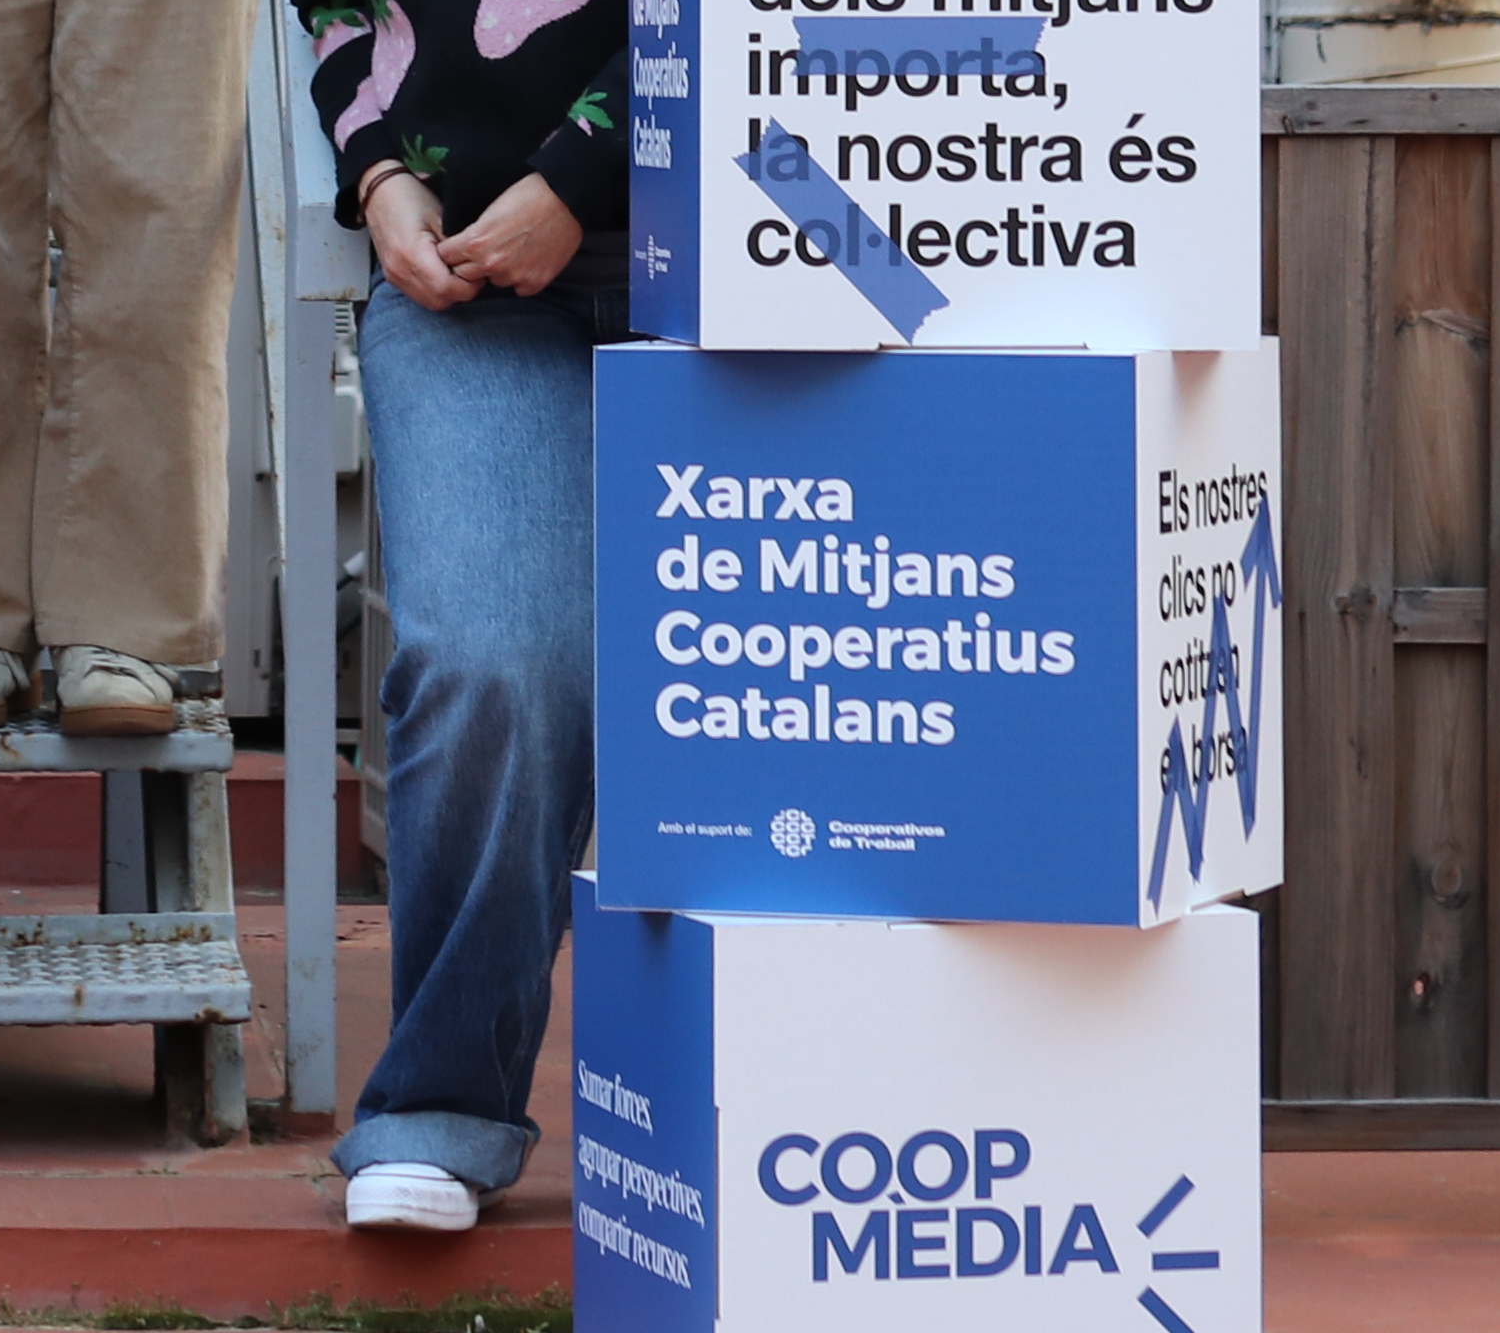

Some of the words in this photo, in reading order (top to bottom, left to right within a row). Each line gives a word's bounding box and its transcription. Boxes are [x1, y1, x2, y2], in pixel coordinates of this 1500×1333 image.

[633, 41, 689, 110] Cooperatius
[748, 33, 1069, 111] importa,
[633, 114, 671, 169] Catalans
[747, 118, 810, 182] la
[837, 123, 1083, 183] nostra
[1108, 113, 1197, 183] és
[746, 203, 1137, 268] col·lectiva
[656, 464, 854, 522] Xarxa
[1159, 469, 1190, 534] Els
[1195, 463, 1268, 528] nostres
[656, 534, 743, 592] de
[760, 535, 1016, 609] Mitjans
[1159, 555, 1206, 621] clics
[1212, 560, 1236, 608] no
[655, 611, 1076, 682] Cooperatius
[655, 683, 955, 745] Catalans
[657, 821, 684, 834] Amb
[697, 824, 733, 838] suport
[828, 820, 947, 838] Cooperatives
[828, 836, 852, 849] de
[855, 836, 916, 852] Treball
[578, 1059, 613, 1113] Sumar
[578, 1134, 622, 1189] agrupar
[757, 1129, 1031, 1207] COOP
[578, 1200, 632, 1259] compartir
